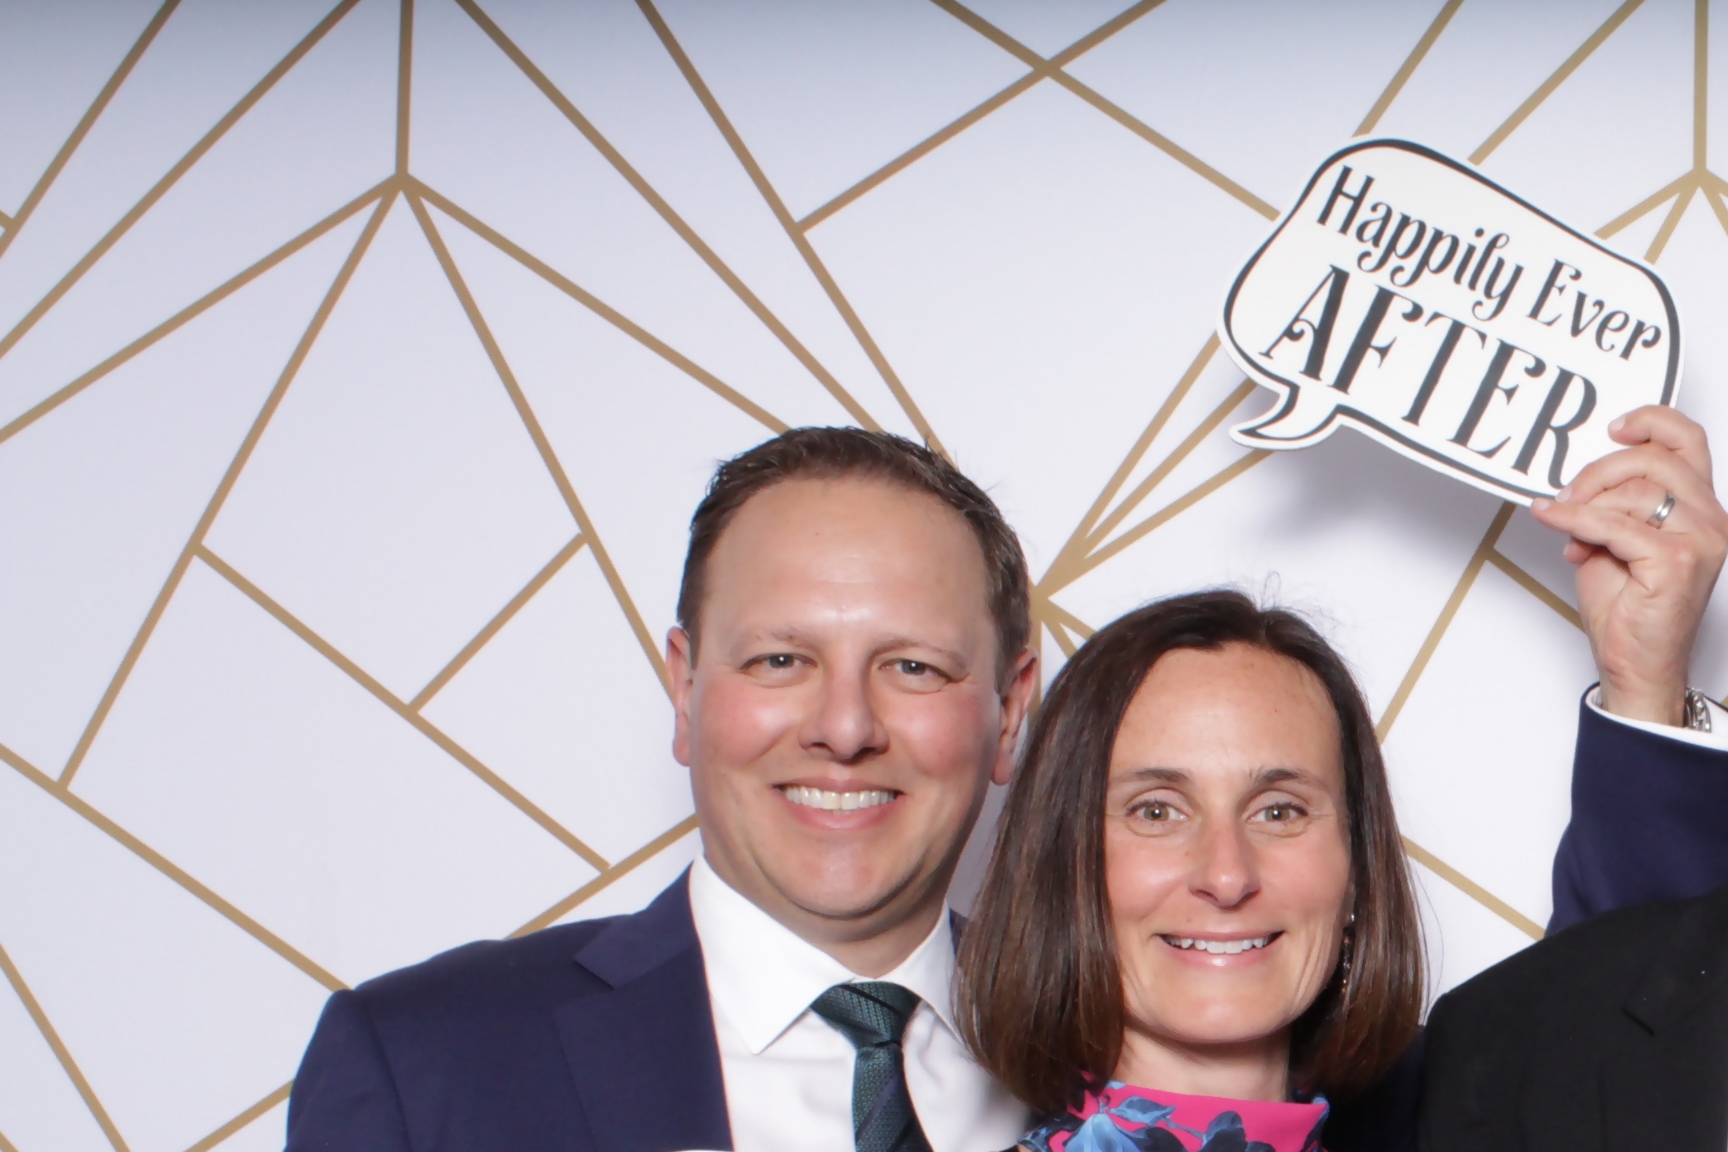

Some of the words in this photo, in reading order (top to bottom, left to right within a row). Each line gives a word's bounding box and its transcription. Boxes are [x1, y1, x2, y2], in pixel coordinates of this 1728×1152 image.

[1316, 165, 1524, 321] Happily
[1526, 258, 1662, 361] Ever
[1258, 264, 1598, 490] AFTER
